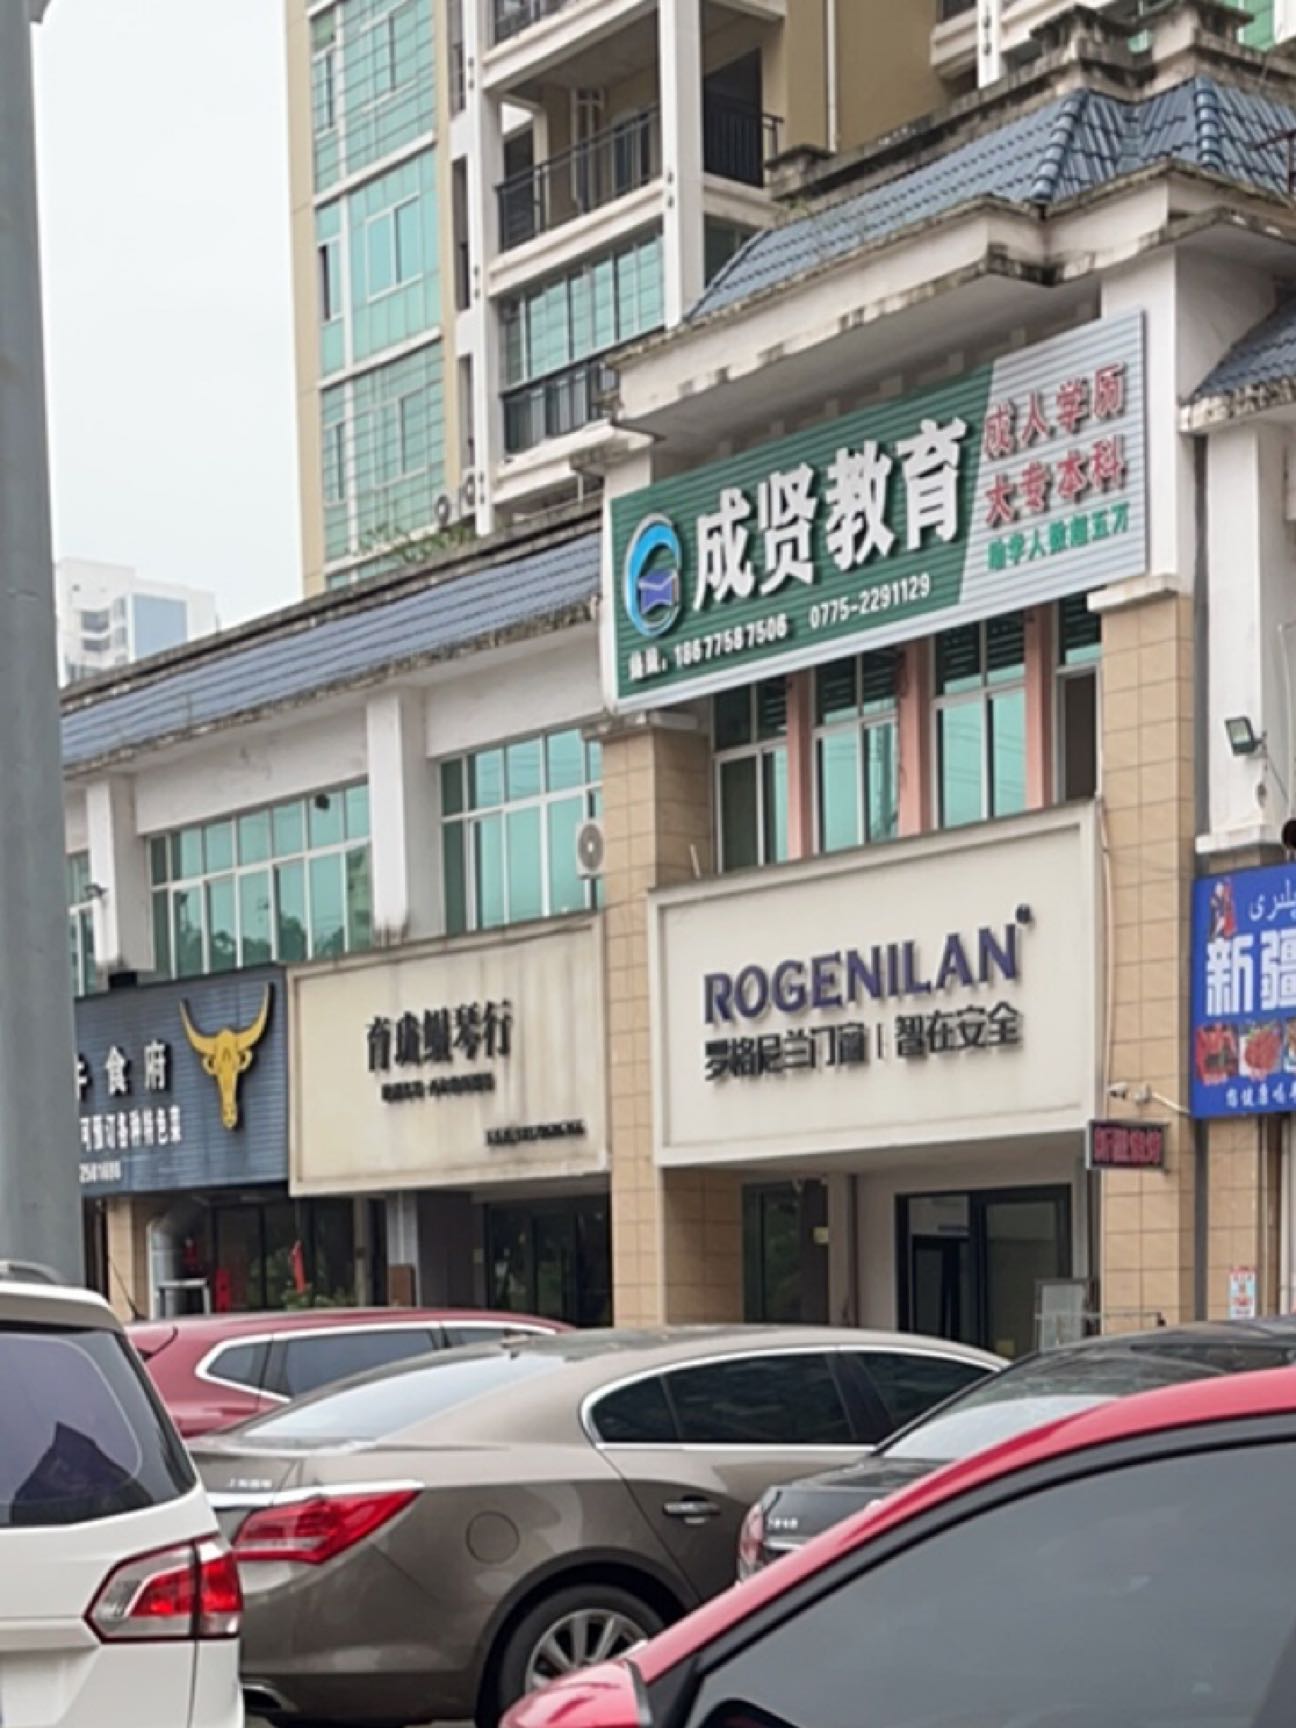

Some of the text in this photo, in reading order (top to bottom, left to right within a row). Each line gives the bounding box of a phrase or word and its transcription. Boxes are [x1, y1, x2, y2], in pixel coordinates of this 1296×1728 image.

[692, 417, 966, 611] 成贤教育
[984, 436, 1126, 527] 大专本科
[808, 572, 931, 629] 0775-2291129
[703, 924, 1018, 1025] ROGENILAN
[895, 1000, 1023, 1058] 智在安全
